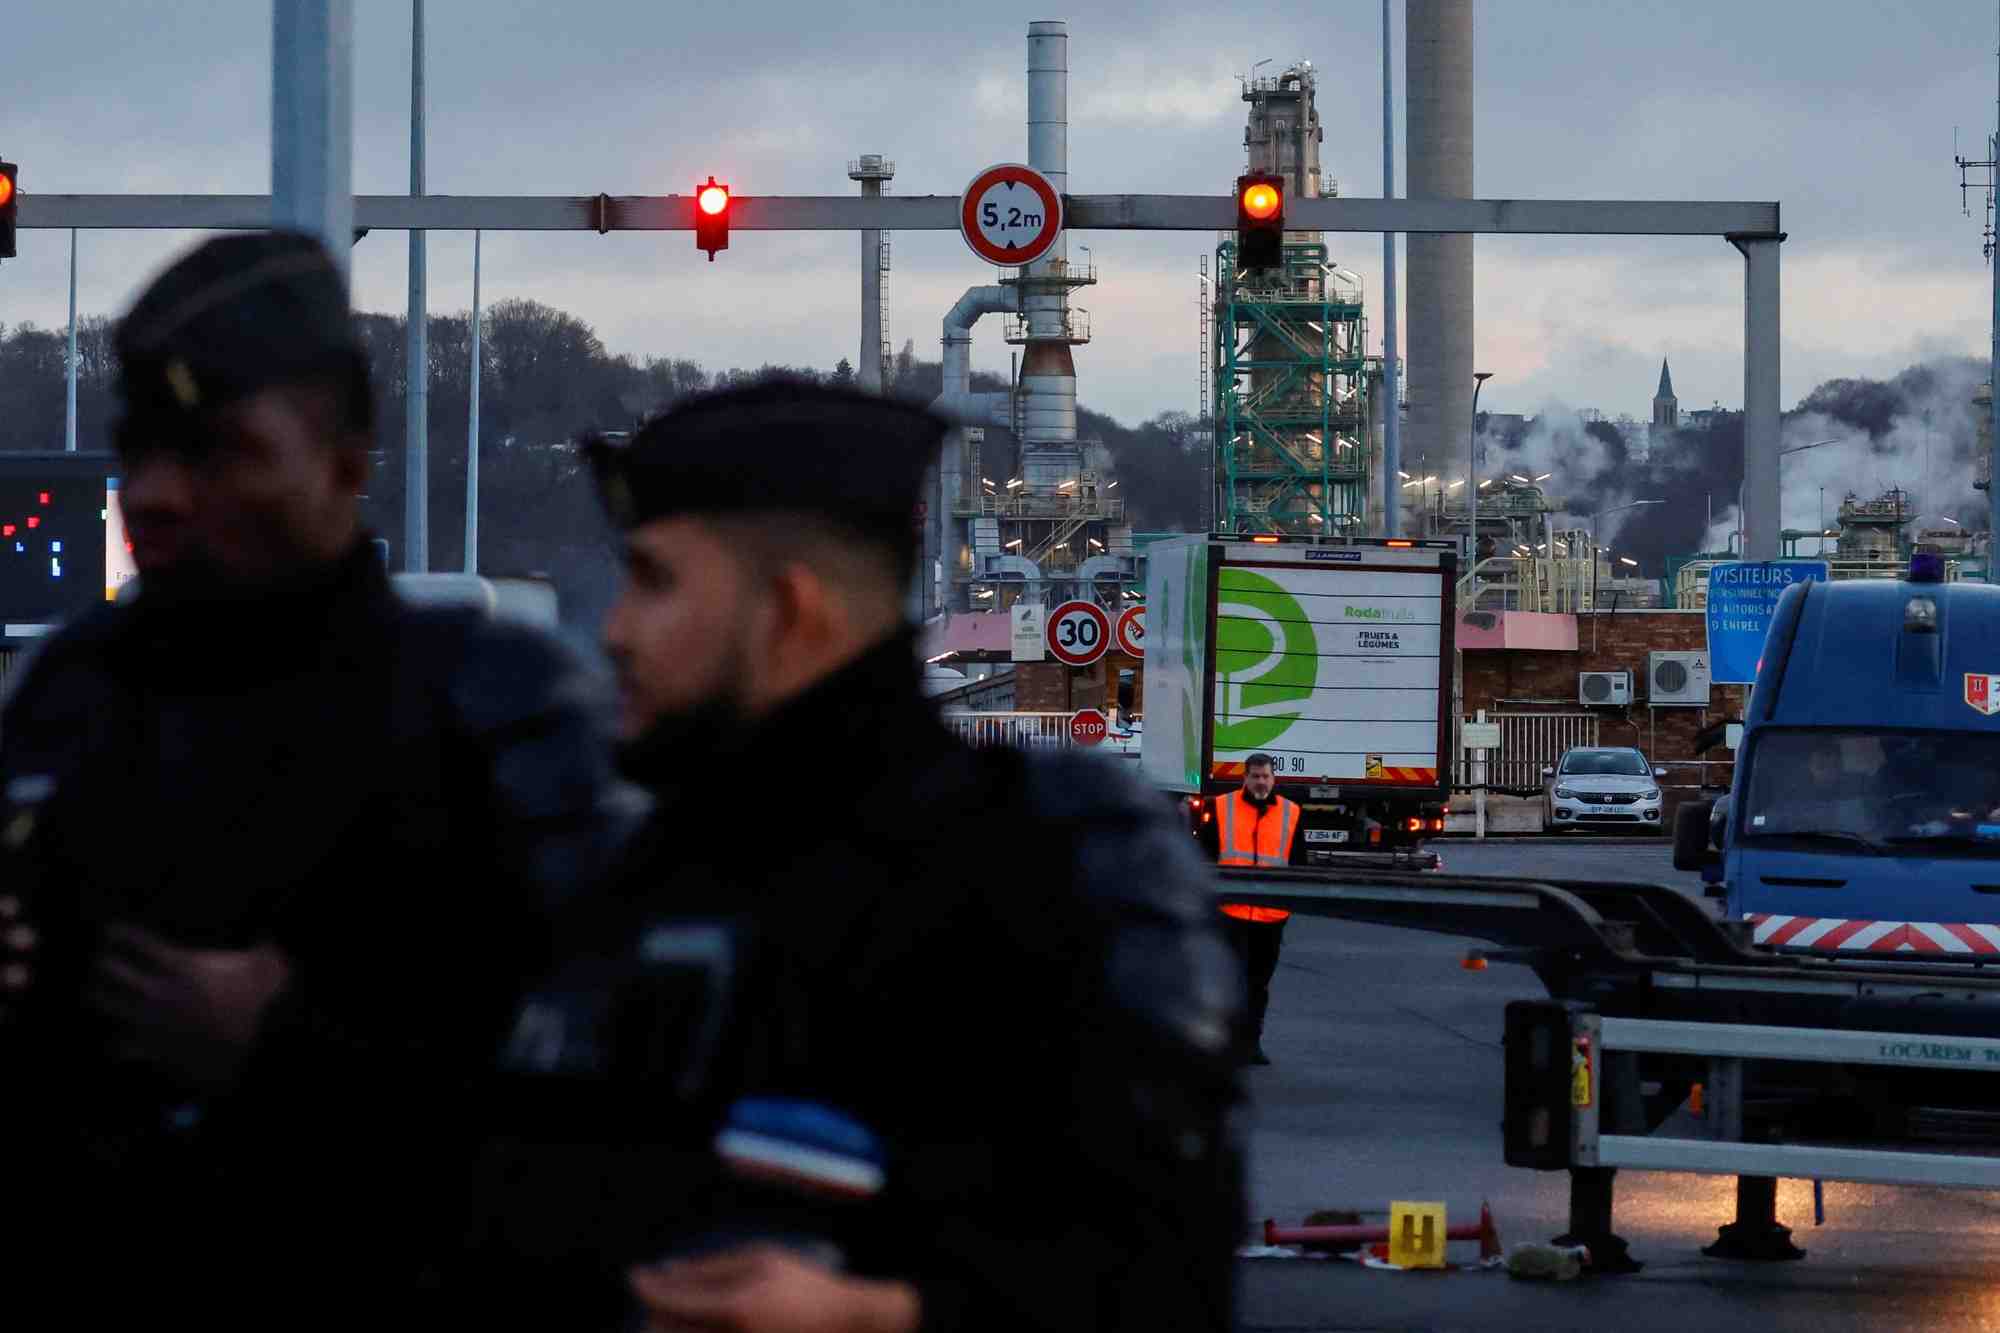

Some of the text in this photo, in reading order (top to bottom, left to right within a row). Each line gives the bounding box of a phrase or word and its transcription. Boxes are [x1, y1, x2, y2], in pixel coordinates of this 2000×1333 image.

[983, 203, 1041, 231] 5,2m
[1714, 568, 1793, 584] VISITEURS
[1060, 619, 1098, 646] 30
[1359, 631, 1399, 640] FRUITS &
[1074, 723, 1104, 735] STOP
[1292, 757, 1304, 772] 90
